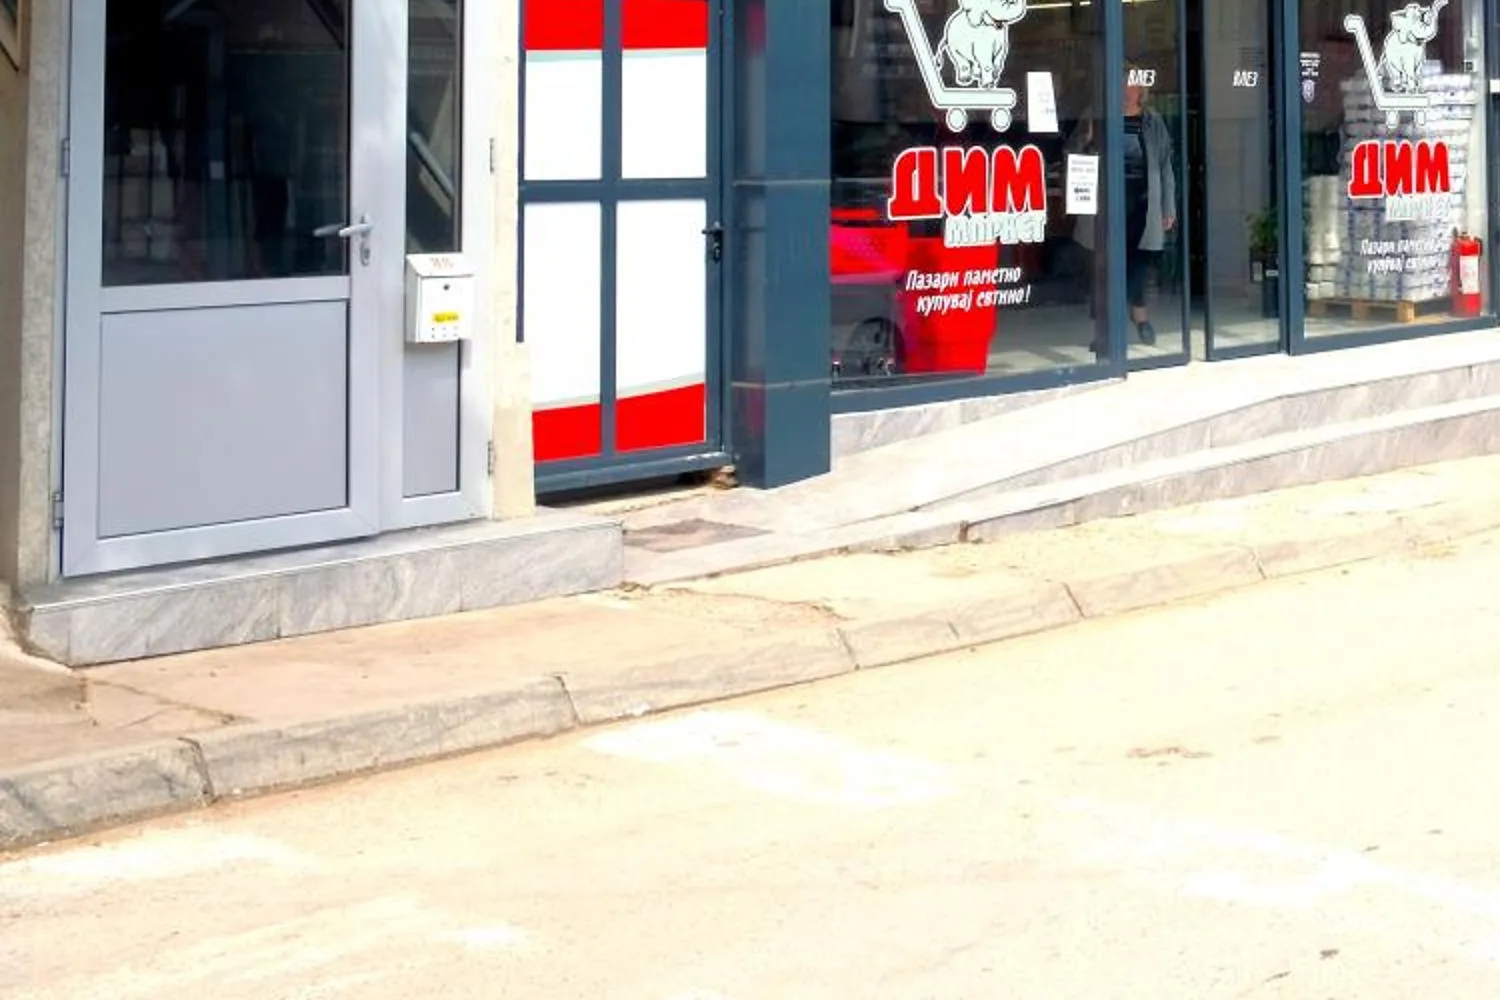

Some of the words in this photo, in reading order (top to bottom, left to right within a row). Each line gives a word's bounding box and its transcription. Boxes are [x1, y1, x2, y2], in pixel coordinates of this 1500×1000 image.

[887, 144, 1047, 221] ДИМ
[1347, 139, 1450, 198] ДИМ
[905, 269, 959, 293] Пазари
[963, 267, 1022, 288] паметно
[916, 287, 973, 316] купувај
[976, 284, 1032, 308] евтино!
